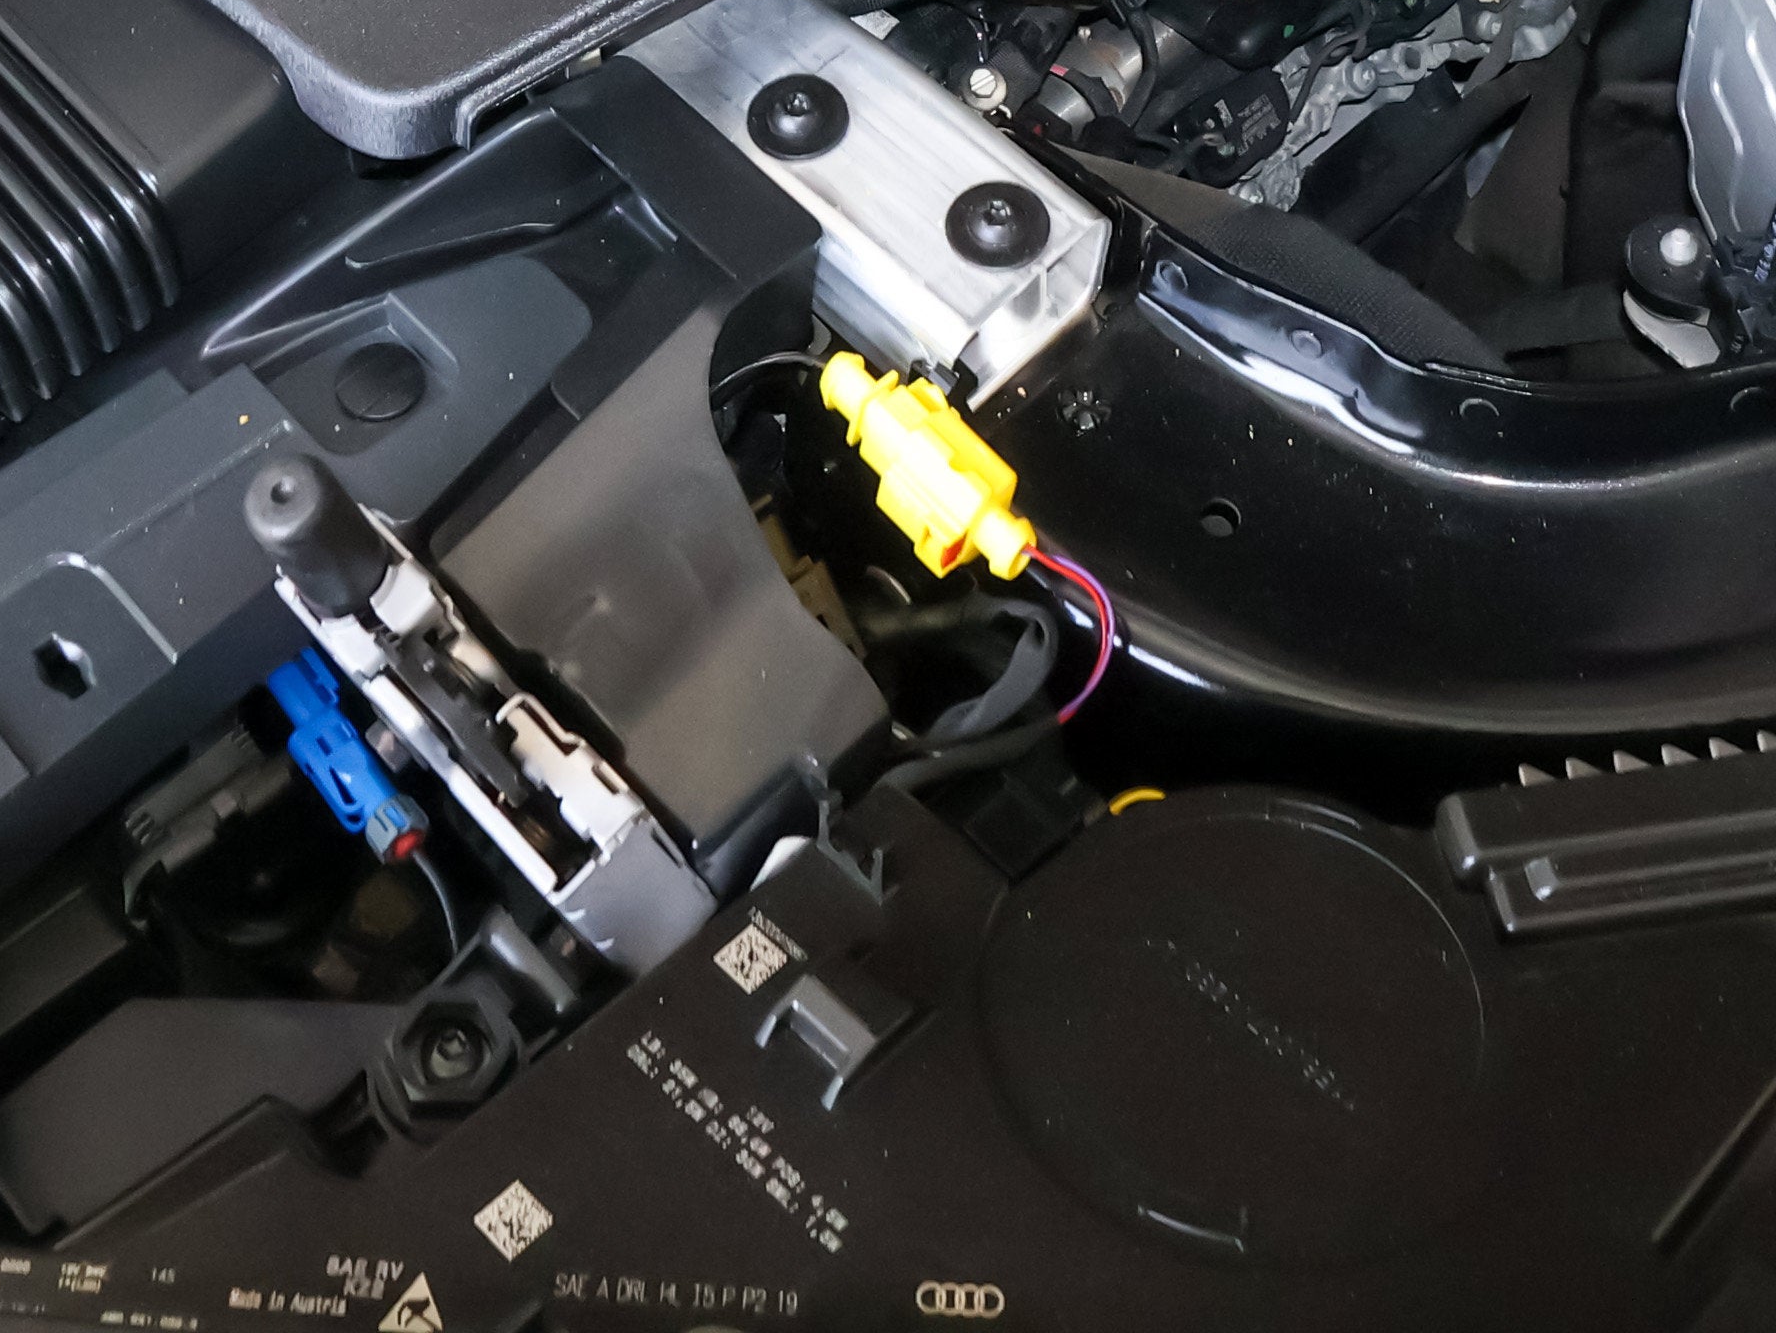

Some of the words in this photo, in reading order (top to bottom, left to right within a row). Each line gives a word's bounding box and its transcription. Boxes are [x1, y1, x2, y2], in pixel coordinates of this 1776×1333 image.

[268, 1291, 286, 1312] in
[290, 1292, 347, 1317] Austria
[554, 1273, 587, 1301] SAE
[596, 1276, 609, 1300] A
[723, 1286, 735, 1307] P
[743, 1286, 767, 1313] P2
